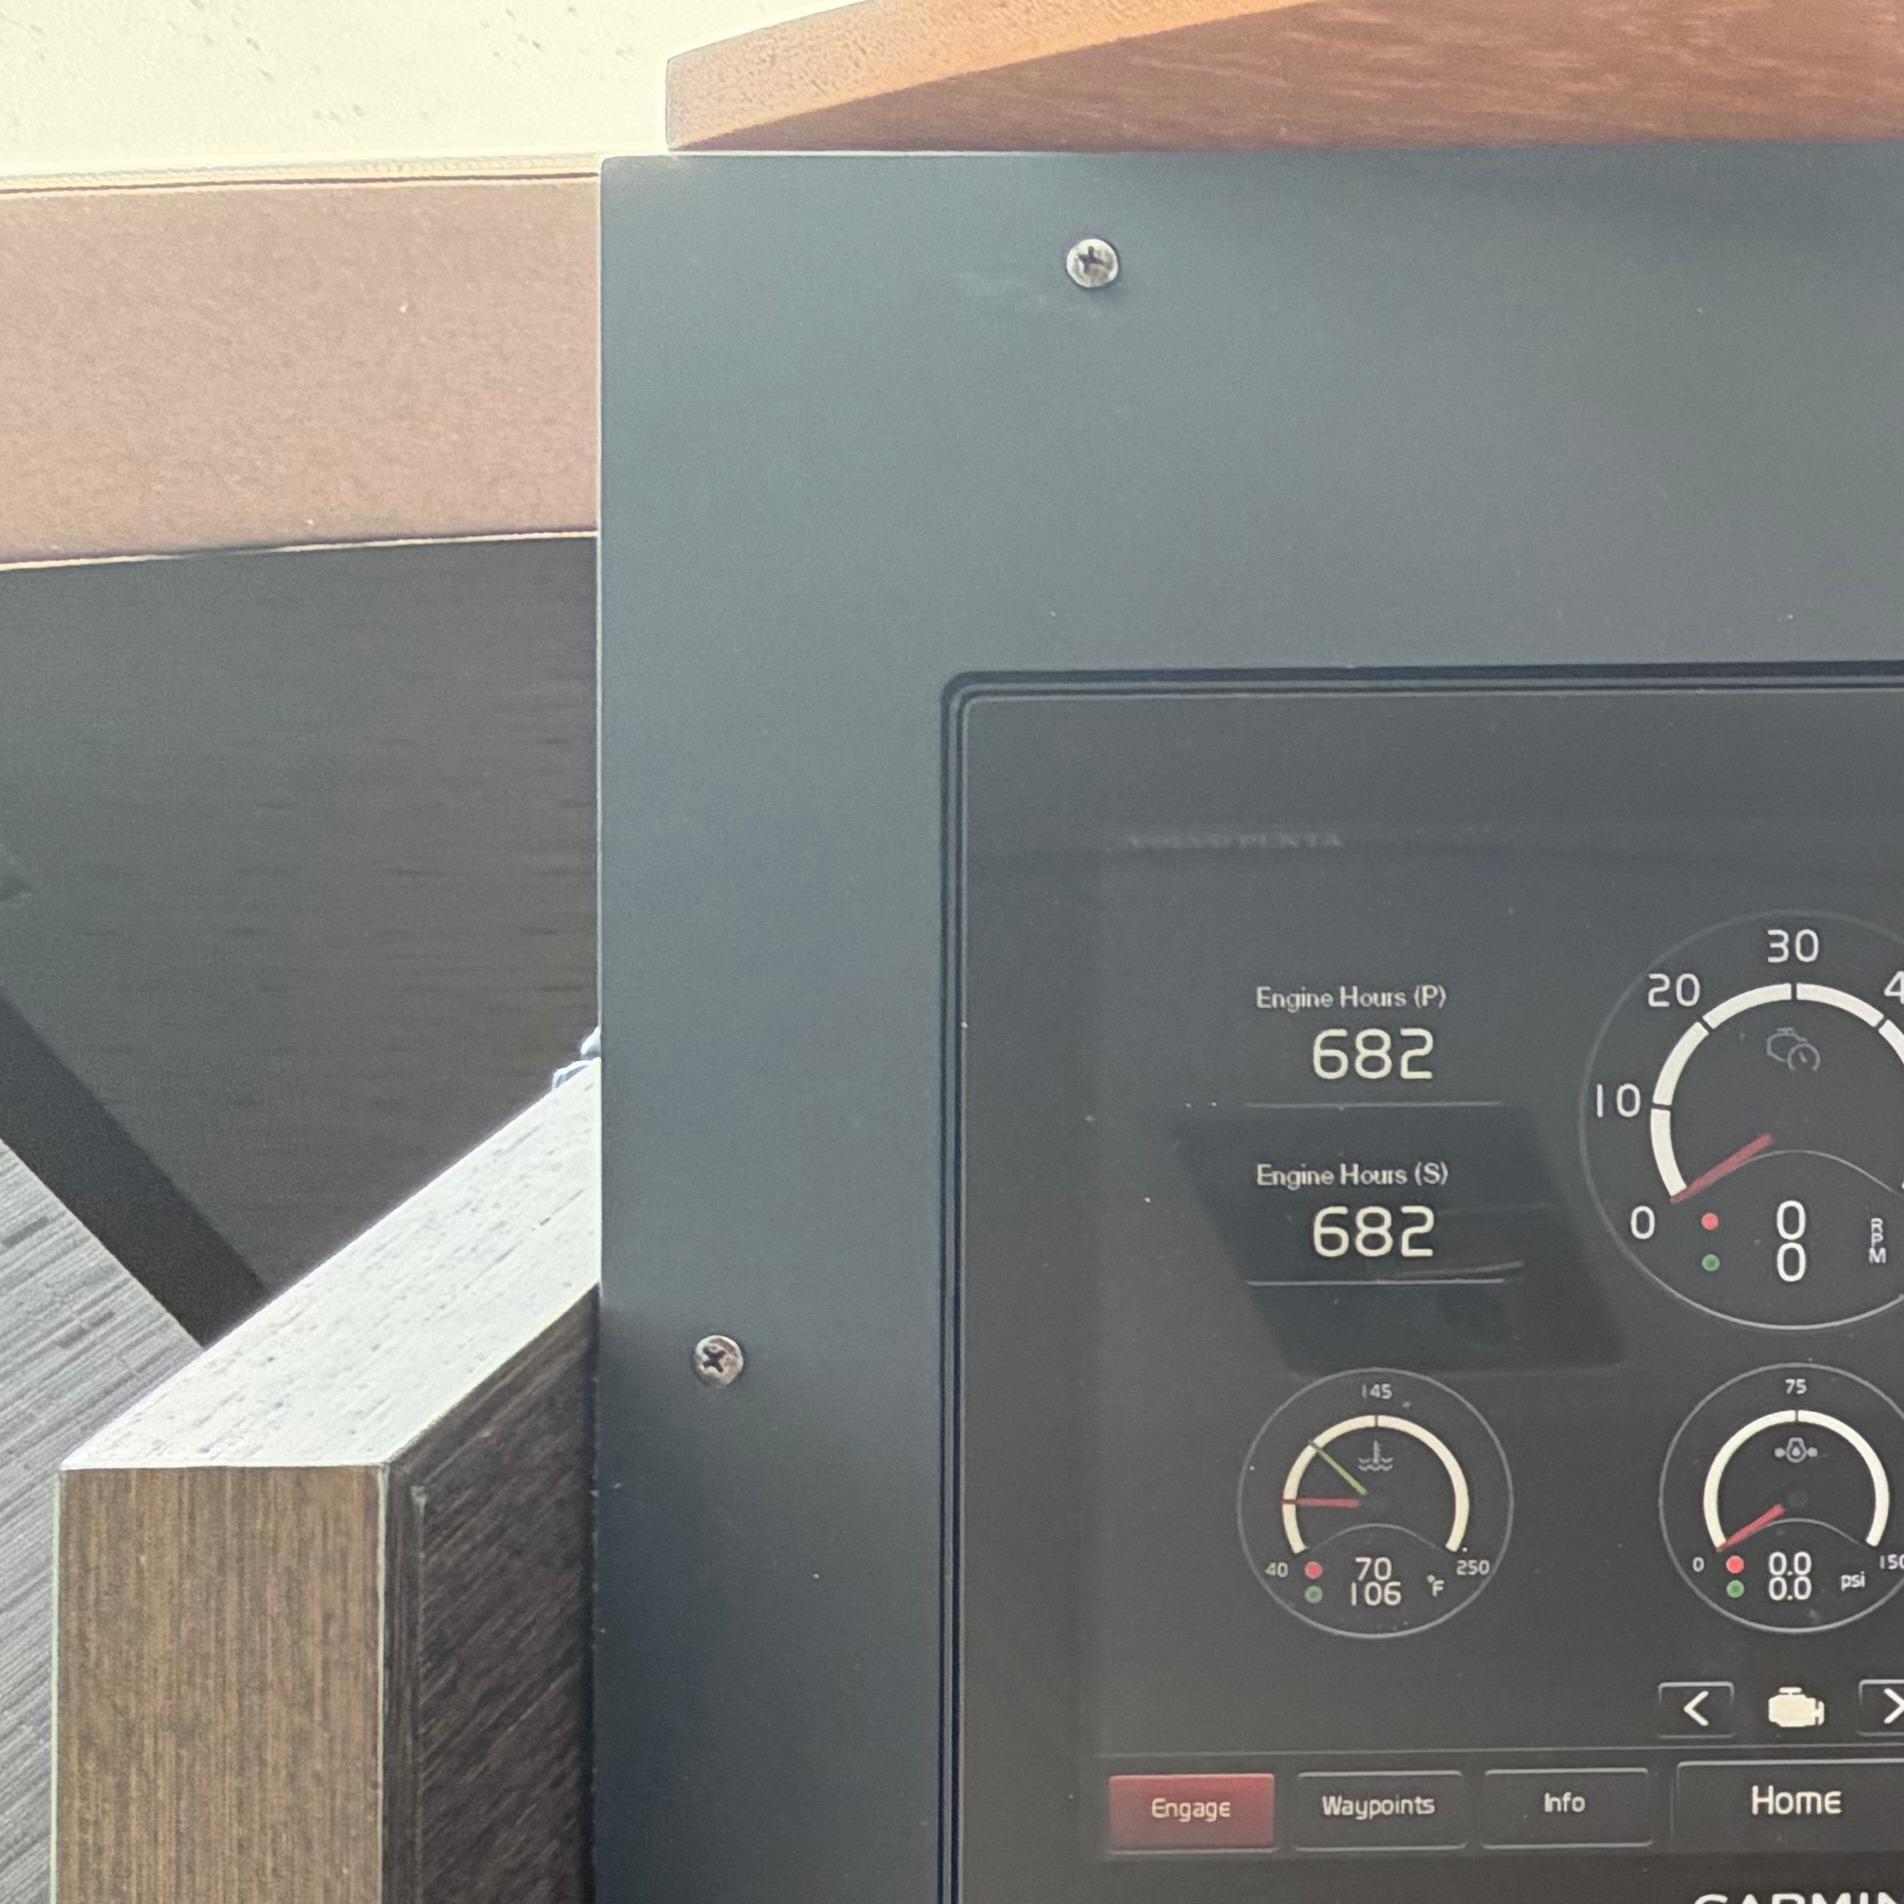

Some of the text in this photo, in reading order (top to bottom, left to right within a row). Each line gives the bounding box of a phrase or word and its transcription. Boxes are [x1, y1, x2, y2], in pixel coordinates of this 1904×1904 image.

[1767, 929, 1820, 963] 30
[1256, 984, 1447, 1013] Engine Hours (P)
[1648, 973, 1701, 1007] 20
[1313, 1028, 1434, 1079] 682
[1596, 1083, 1641, 1118] 10
[1256, 1161, 1449, 1190] Engine Hours (S)
[1313, 1205, 1435, 1257] 682
[1630, 1205, 1655, 1239] 0
[1776, 1201, 1806, 1240] 0
[1776, 1242, 1806, 1282] 0
[1361, 1383, 1392, 1400] 145
[1785, 1378, 1808, 1395] 75
[1265, 1562, 1289, 1577] 40
[1355, 1556, 1392, 1581] 70
[1456, 1560, 1490, 1575] 250
[1692, 1557, 1705, 1572] 0
[1350, 1581, 1402, 1606] 106
[1841, 1571, 1866, 1591] psi
[1151, 1798, 1232, 1822] Engage
[1321, 1794, 1436, 1821] Waypoints
[1544, 1792, 1586, 1814] Info
[1751, 1785, 1842, 1815] Home
